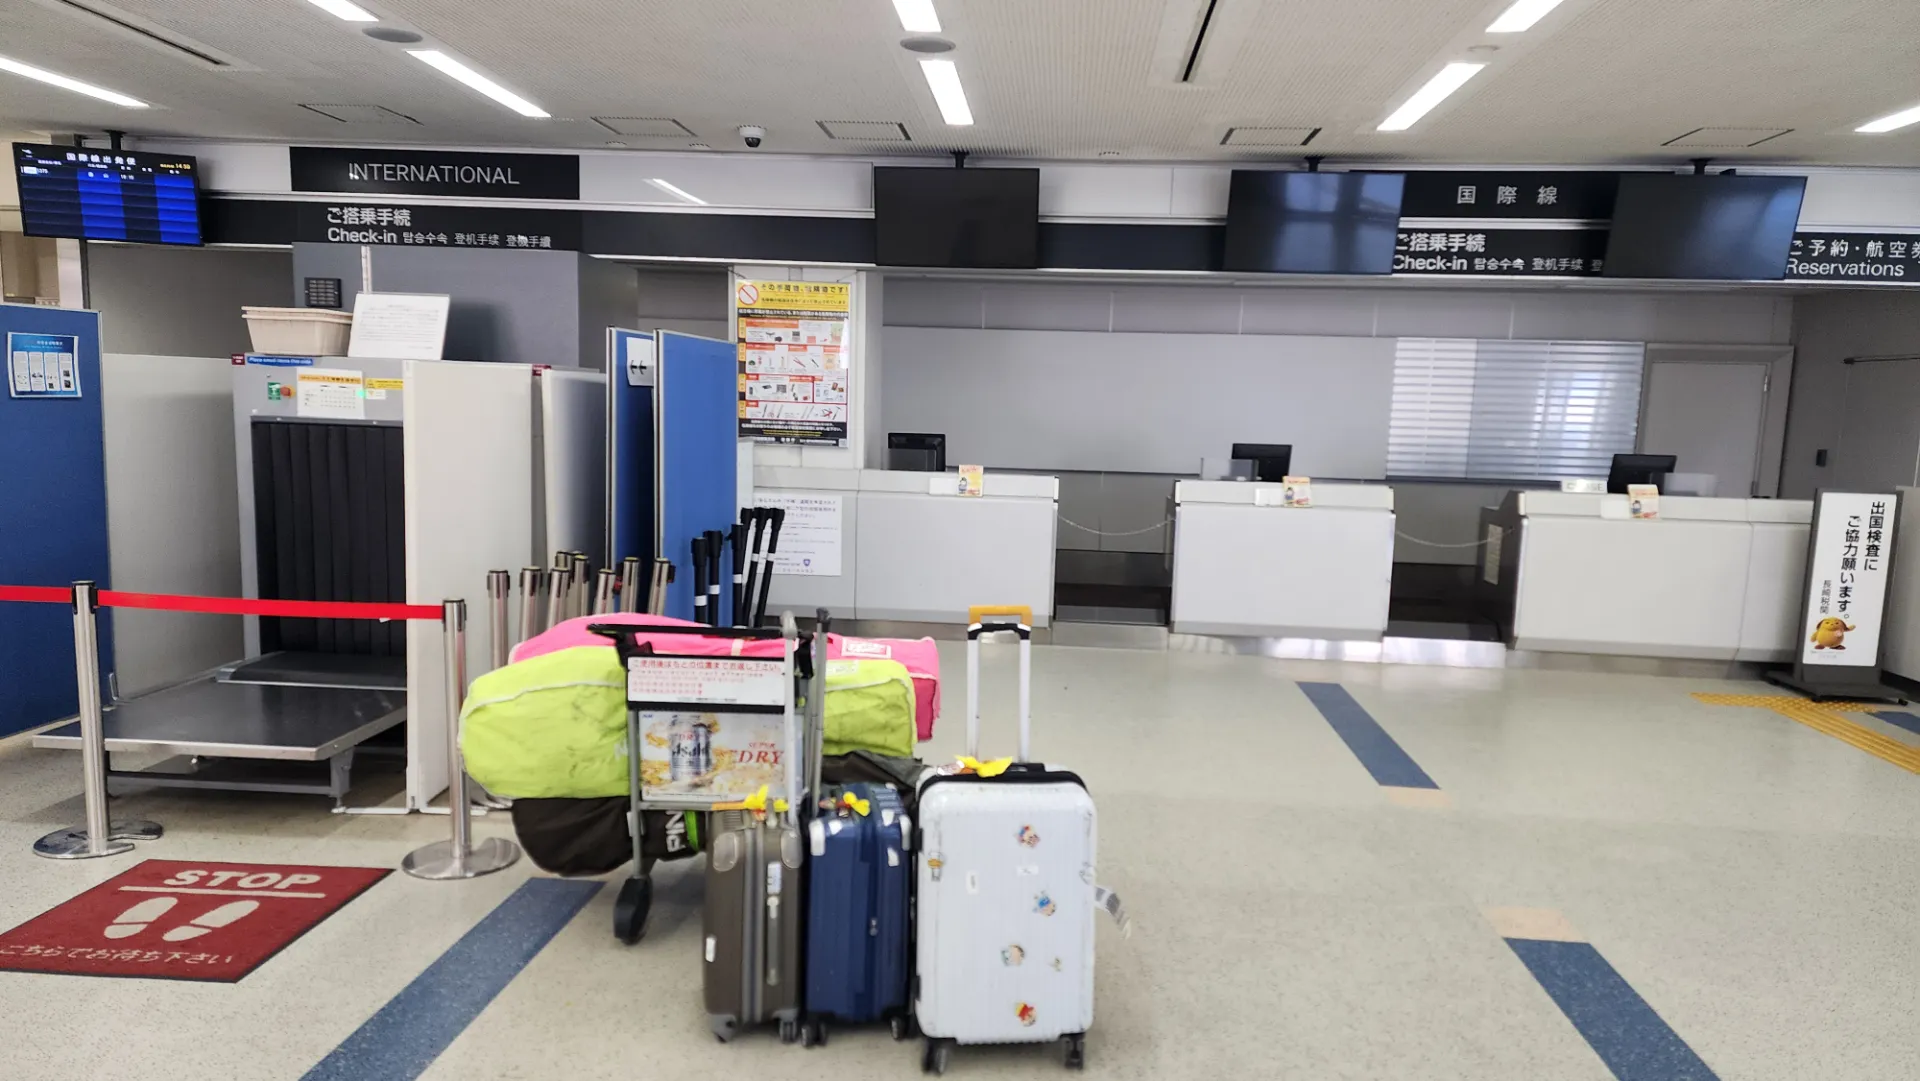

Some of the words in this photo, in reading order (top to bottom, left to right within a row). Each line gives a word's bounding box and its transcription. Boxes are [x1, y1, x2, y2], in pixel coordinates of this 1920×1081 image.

[349, 162, 520, 185] INTERNATIONAL
[1456, 185, 1558, 205] 国際線
[327, 207, 411, 227] ご搭乗手続
[327, 226, 397, 244] Check-in
[403, 231, 448, 245] 탑승수속
[1395, 232, 1486, 252] ご搭乗手続
[1392, 254, 1468, 271] Check-in
[1474, 257, 1525, 271] 탑승수속
[1786, 258, 1905, 277] Reservations
[1863, 500, 1886, 572] 出国検査に
[1836, 514, 1863, 620] ご協力願います。
[164, 869, 322, 890] STOP
